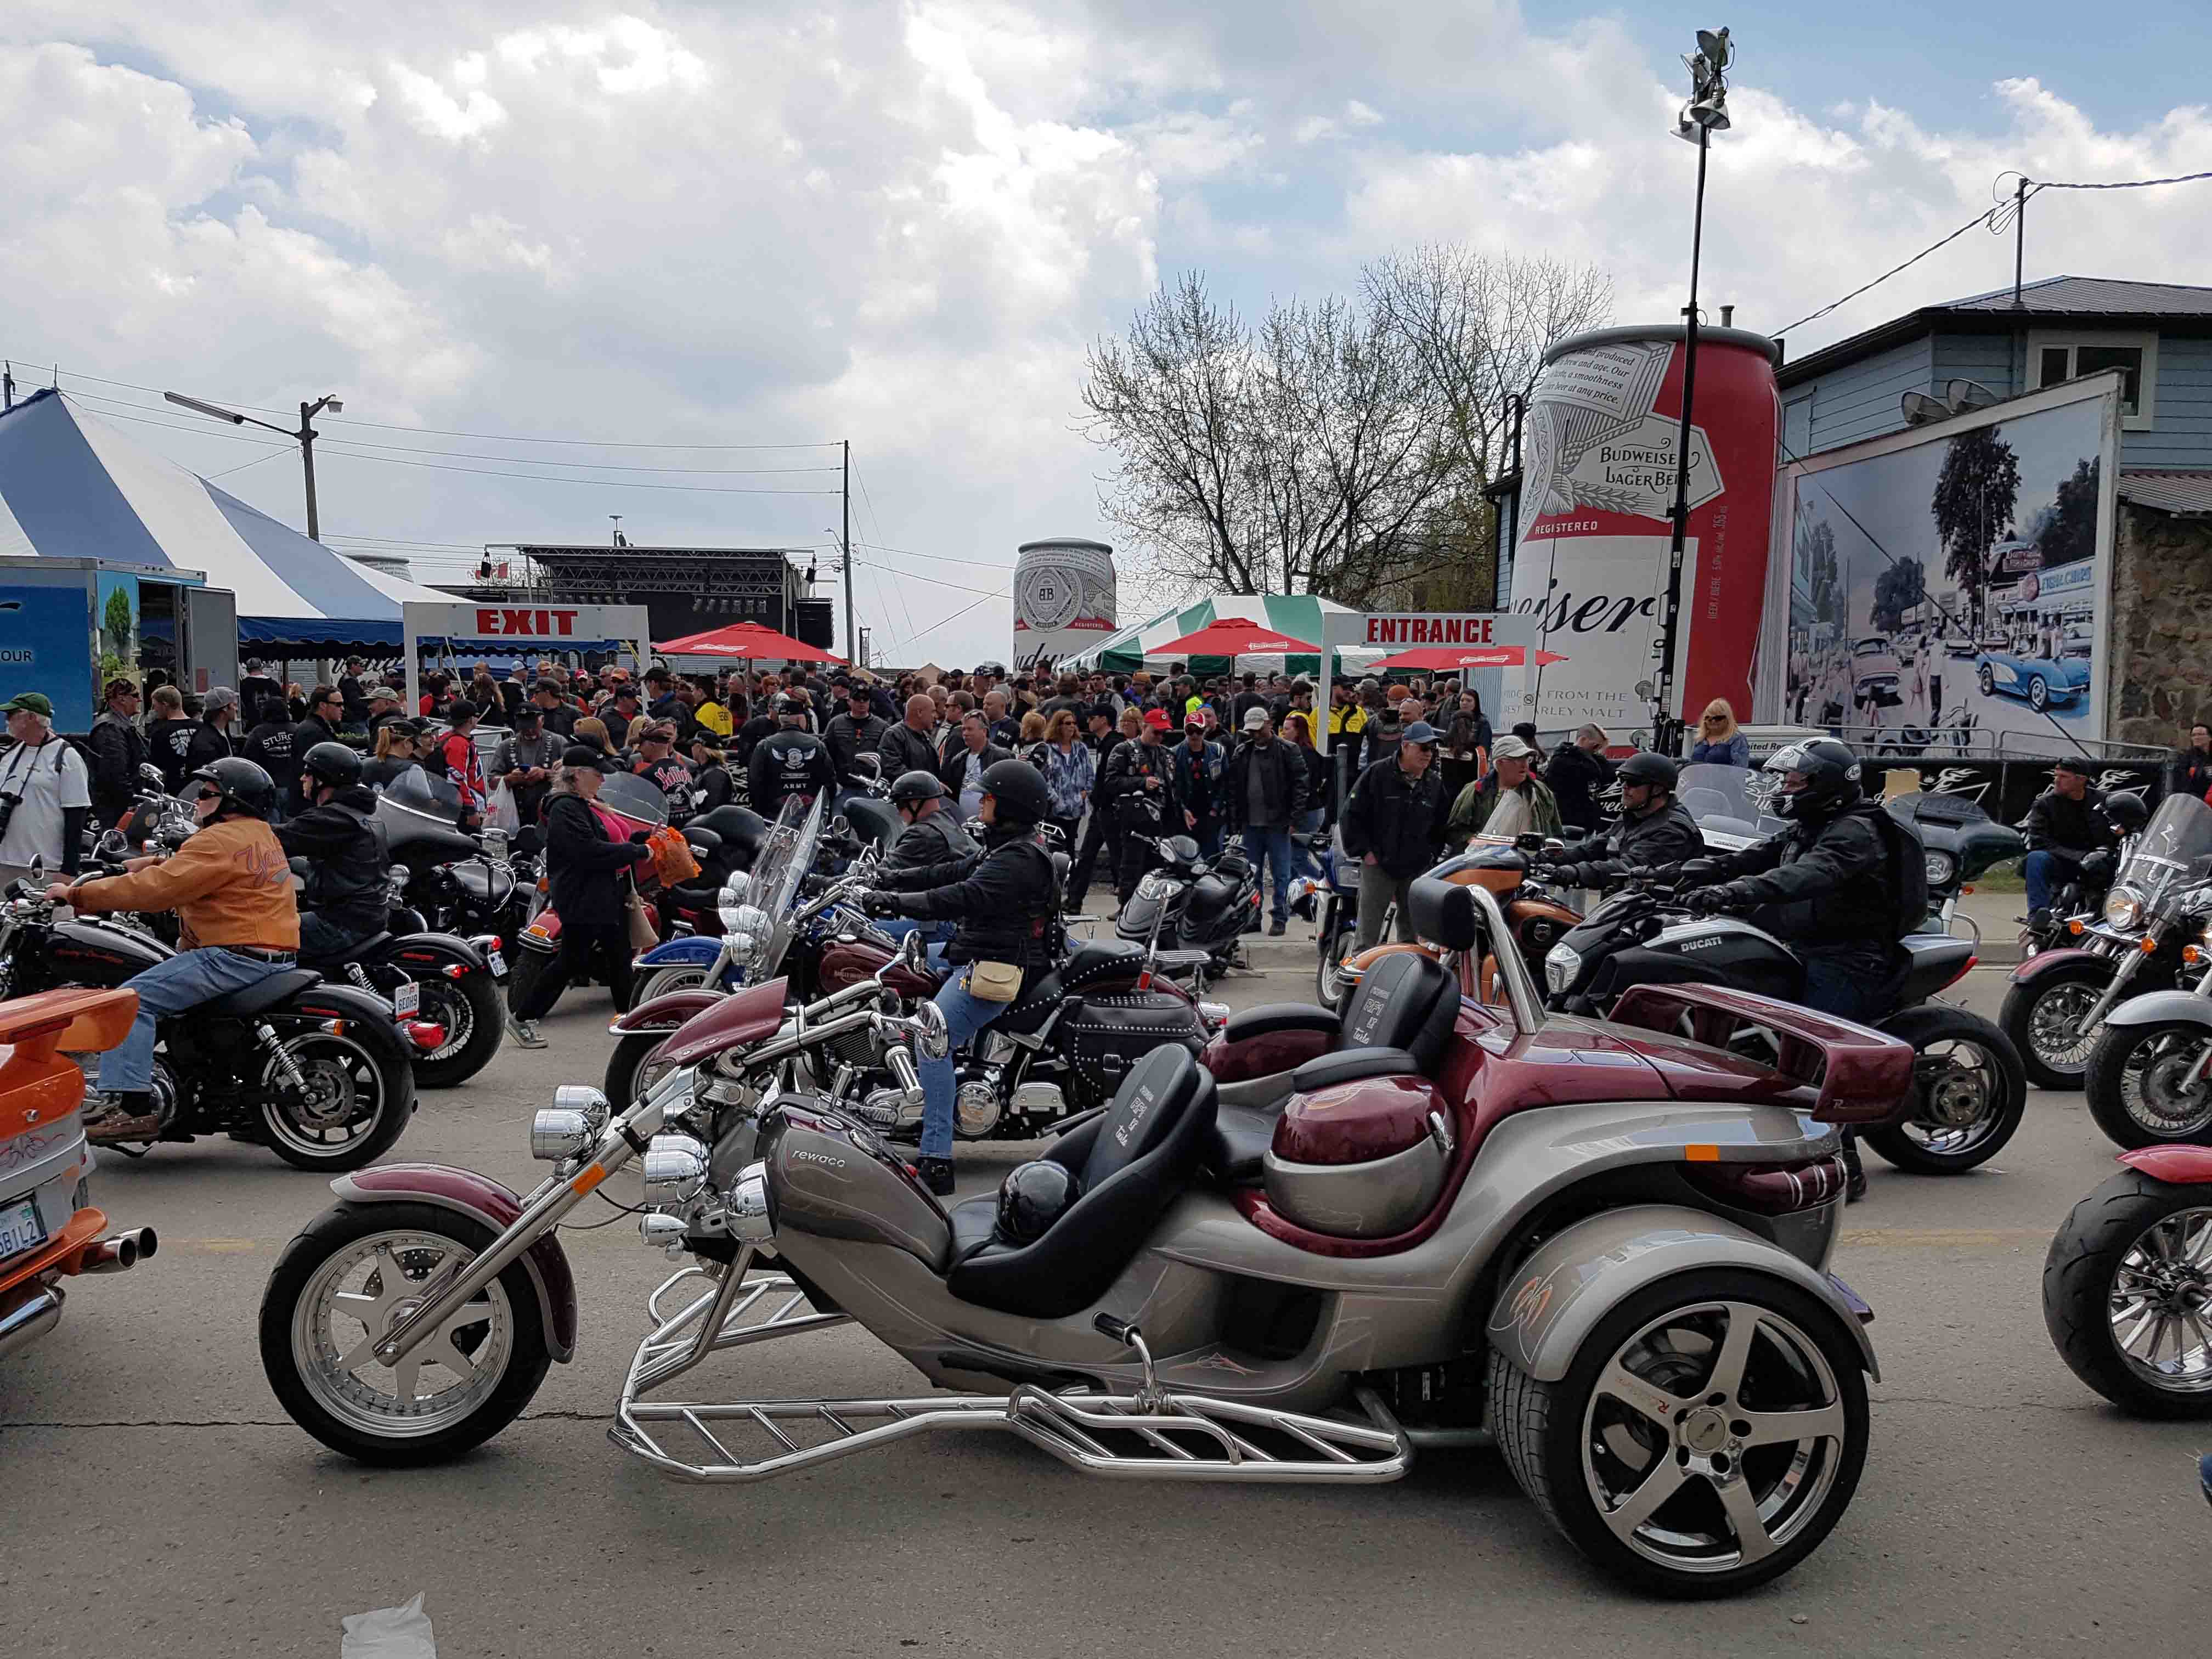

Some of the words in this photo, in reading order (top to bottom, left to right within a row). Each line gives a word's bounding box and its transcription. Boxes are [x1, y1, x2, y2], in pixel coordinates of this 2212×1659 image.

[1596, 351, 1635, 366] produced
[1578, 360, 1594, 368] and
[1593, 362, 1609, 373] age.
[1611, 366, 1629, 378] Our
[1573, 372, 1624, 390] smoothness
[1577, 387, 1593, 397] any
[1592, 390, 1619, 404] price.
[1600, 447, 1678, 465] BUDWEISE
[1655, 471, 1691, 487] BER
[1534, 521, 1598, 535] REGISTERED
[476, 609, 578, 635] EXIT
[1367, 618, 1493, 643] ENTRANCE
[1547, 690, 1589, 701] FROM
[1596, 691, 1629, 702] THE
[1536, 706, 1576, 716] ARLEY
[1581, 708, 1627, 719] MALT
[1680, 936, 1722, 952] DUCATI
[792, 1150, 845, 1167] rewaco
